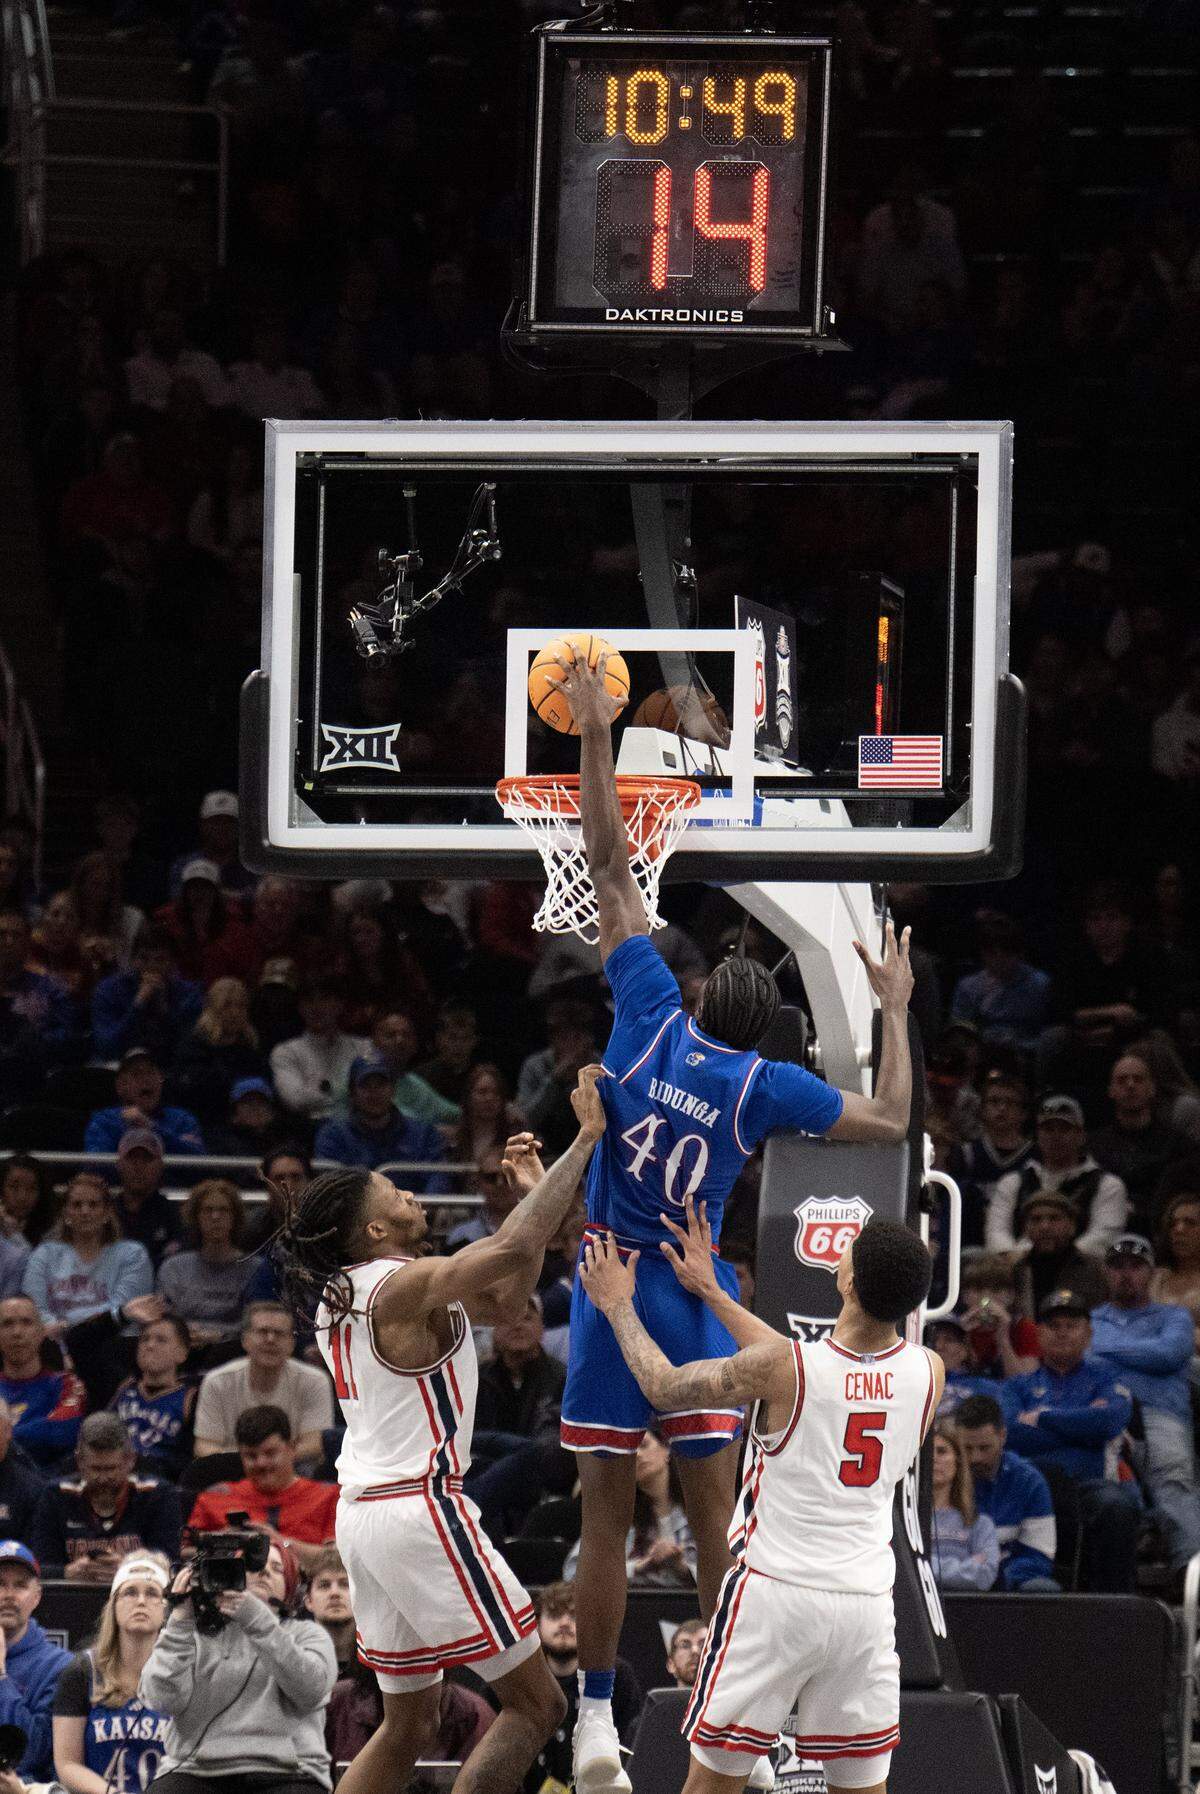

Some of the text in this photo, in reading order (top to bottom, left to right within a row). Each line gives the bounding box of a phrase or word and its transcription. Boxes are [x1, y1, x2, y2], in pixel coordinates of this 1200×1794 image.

[604, 70, 796, 146] 10:49
[650, 166, 771, 292] 14
[605, 307, 744, 323] DAKTRONICS
[648, 1076, 722, 1129] BIDUNGA
[620, 1112, 710, 1208] 40
[806, 1207, 861, 1221] PHILLIPS
[809, 1226, 857, 1255] 66
[844, 1371, 894, 1401] CENAC
[838, 1411, 887, 1488] 5
[92, 1714, 174, 1744] KANSA
